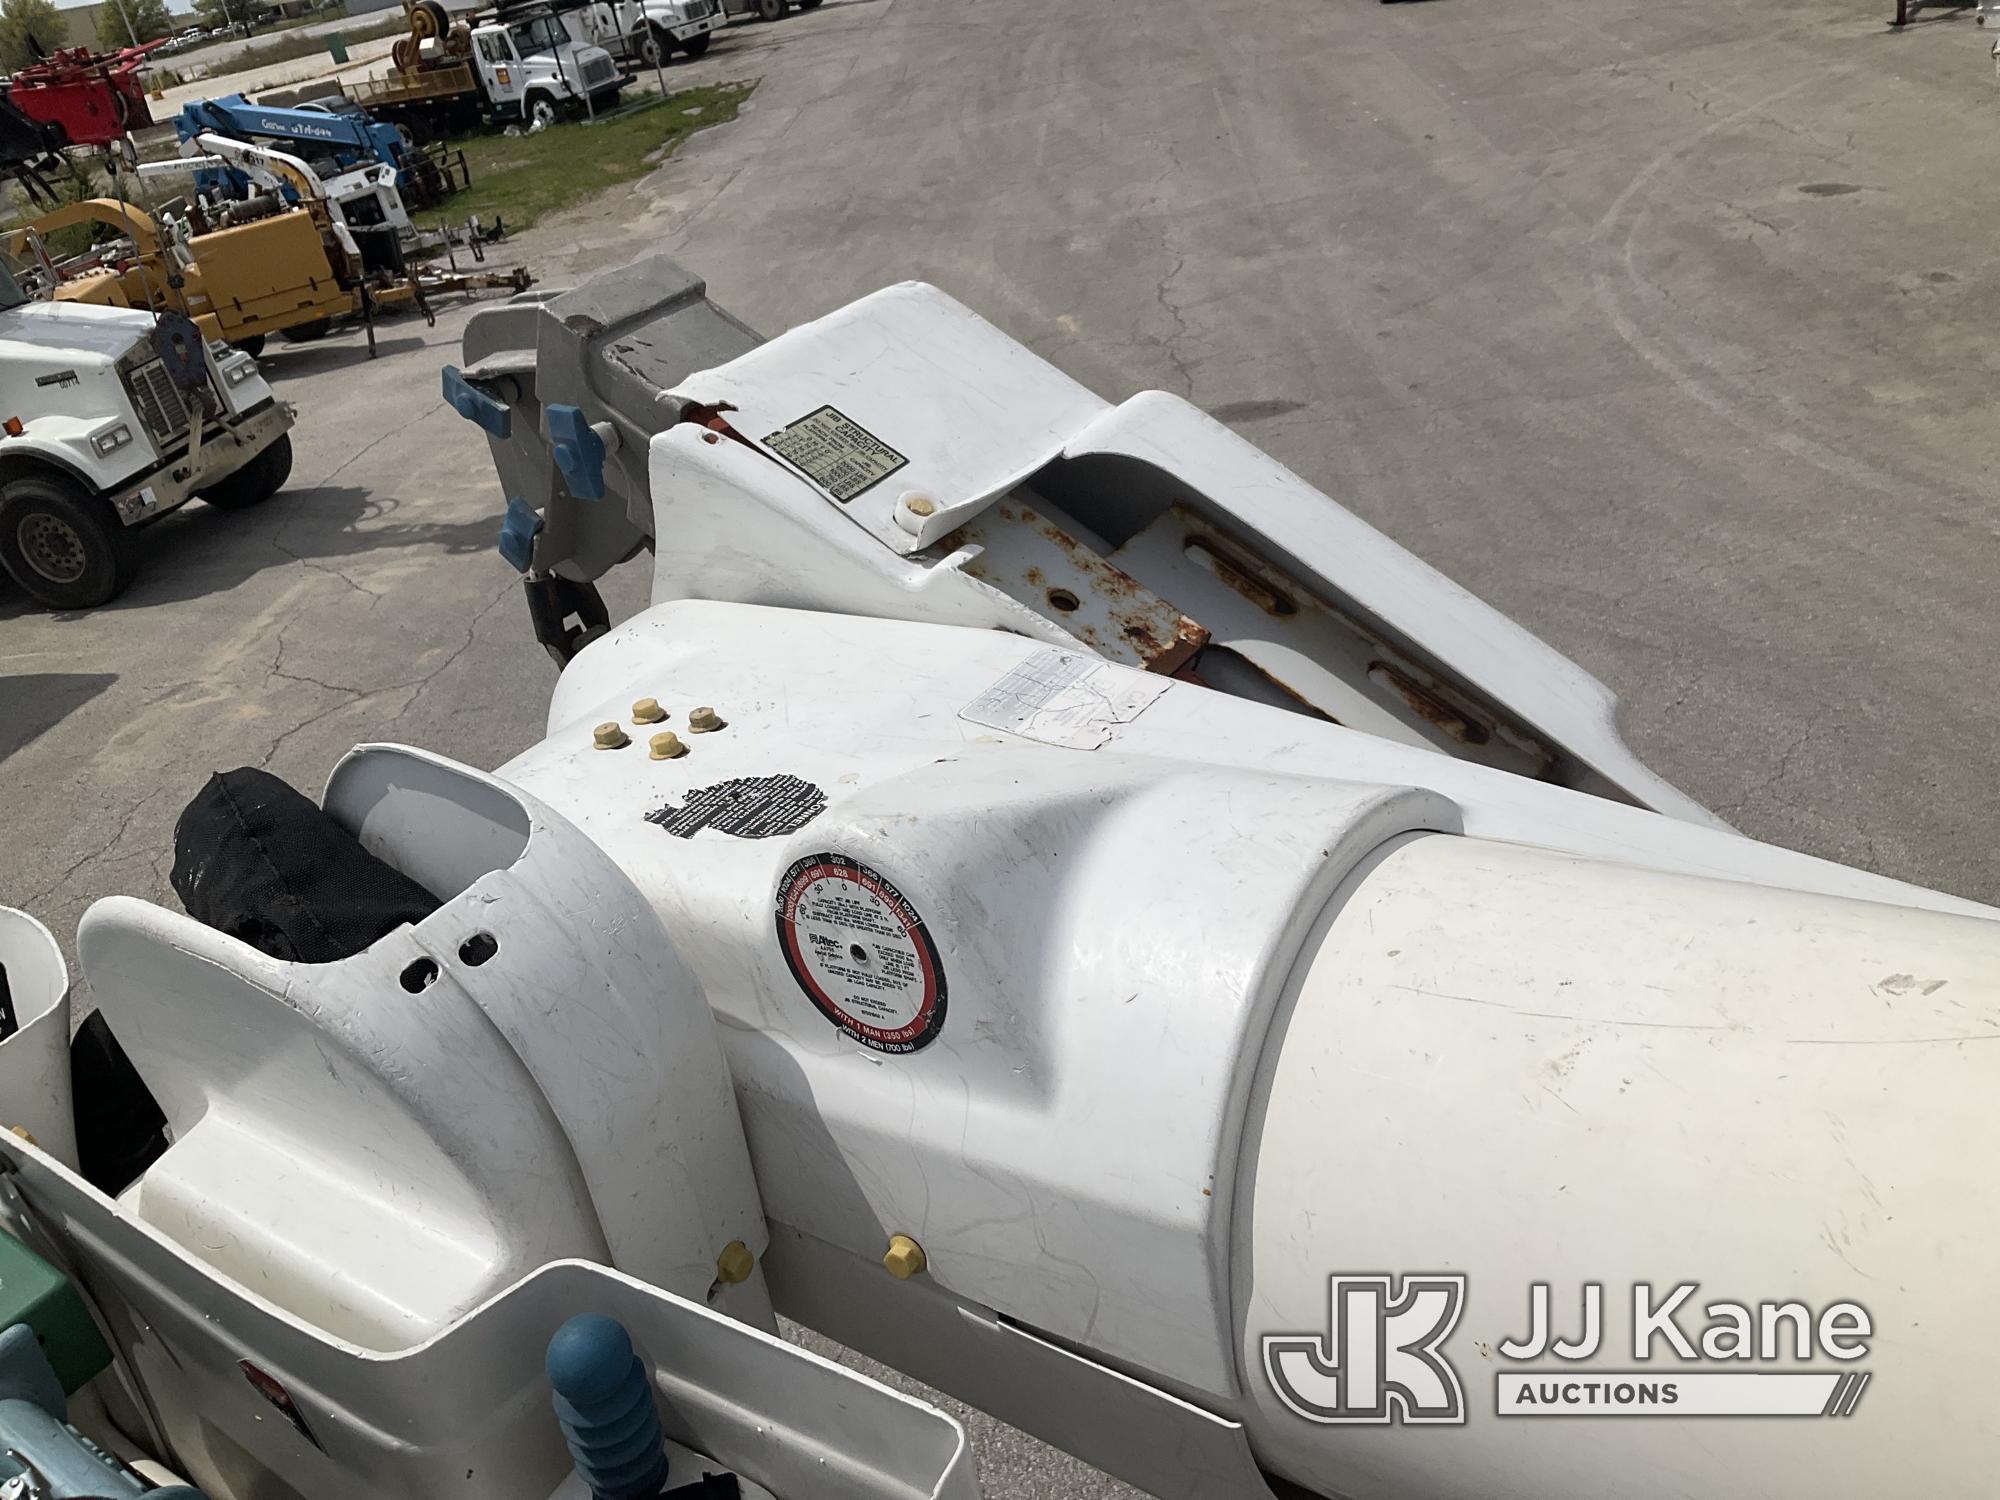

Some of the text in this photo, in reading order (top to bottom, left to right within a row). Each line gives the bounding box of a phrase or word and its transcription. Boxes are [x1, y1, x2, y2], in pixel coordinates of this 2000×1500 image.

[824, 411, 900, 464] JIB STRUCTURAL
[833, 425, 878, 456] CAPACITY
[870, 896, 880, 907] 30
[884, 884, 900, 897] 577
[902, 902, 918, 922] 1024
[895, 908, 911, 928] 1341
[834, 1007, 853, 1025] WITH
[863, 1026, 881, 1038] MAN
[884, 1031, 901, 1040] (350
[902, 1026, 914, 1037] lbs)
[842, 1024, 860, 1040] WITH
[868, 1039, 884, 1050] MEN
[886, 1044, 901, 1052] (700
[901, 1041, 915, 1051] lbs)
